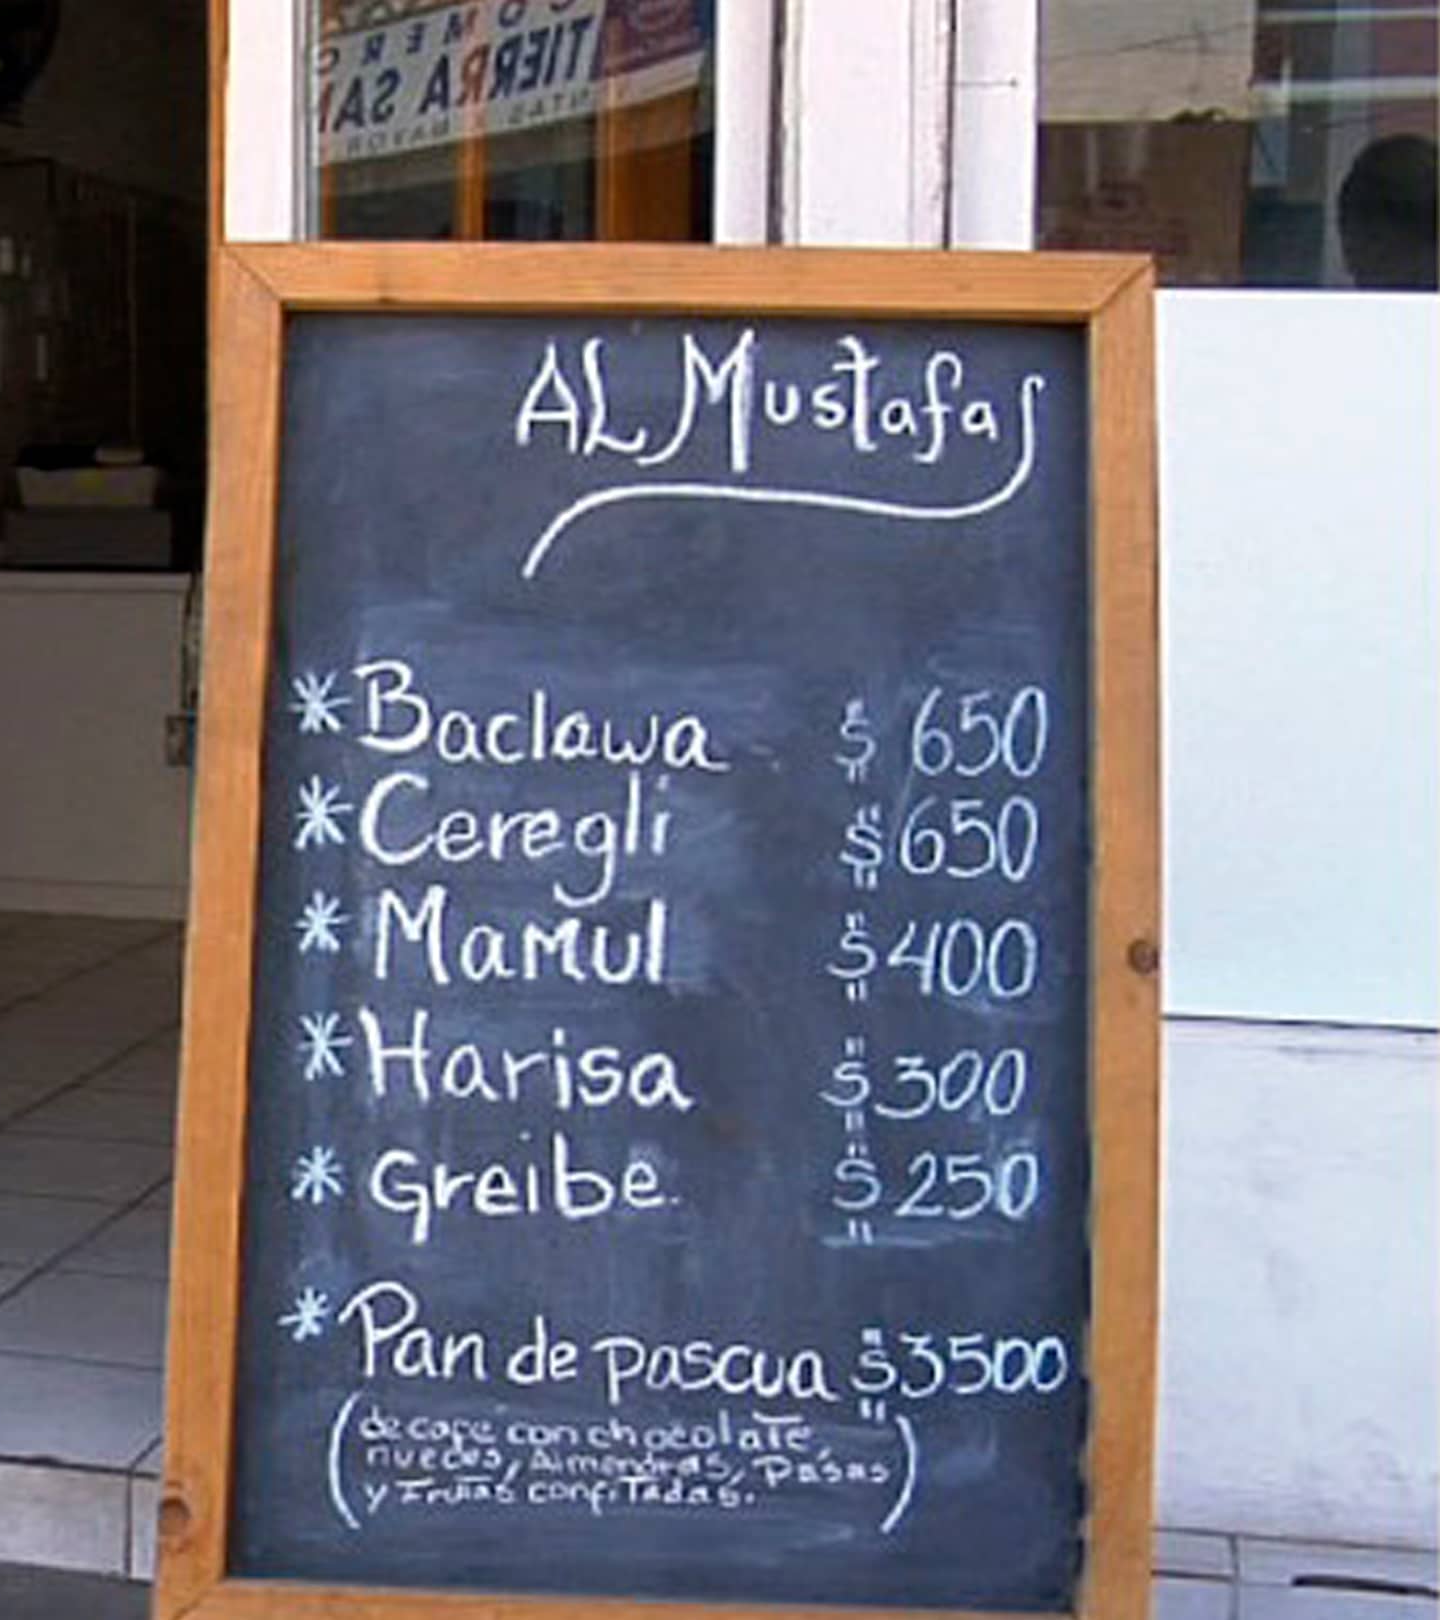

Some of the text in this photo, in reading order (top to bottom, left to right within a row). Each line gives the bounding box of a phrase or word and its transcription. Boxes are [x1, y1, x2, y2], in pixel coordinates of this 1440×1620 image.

[355, 660, 730, 773] Baclawa
[360, 772, 672, 907] Ceregli
[360, 1006, 696, 1112] Harisa
[337, 1281, 489, 1382] Pan
[507, 1315, 579, 1383] de
[588, 1332, 842, 1402] pascua
[507, 1421, 579, 1446] con
[365, 1484, 389, 1513] y
